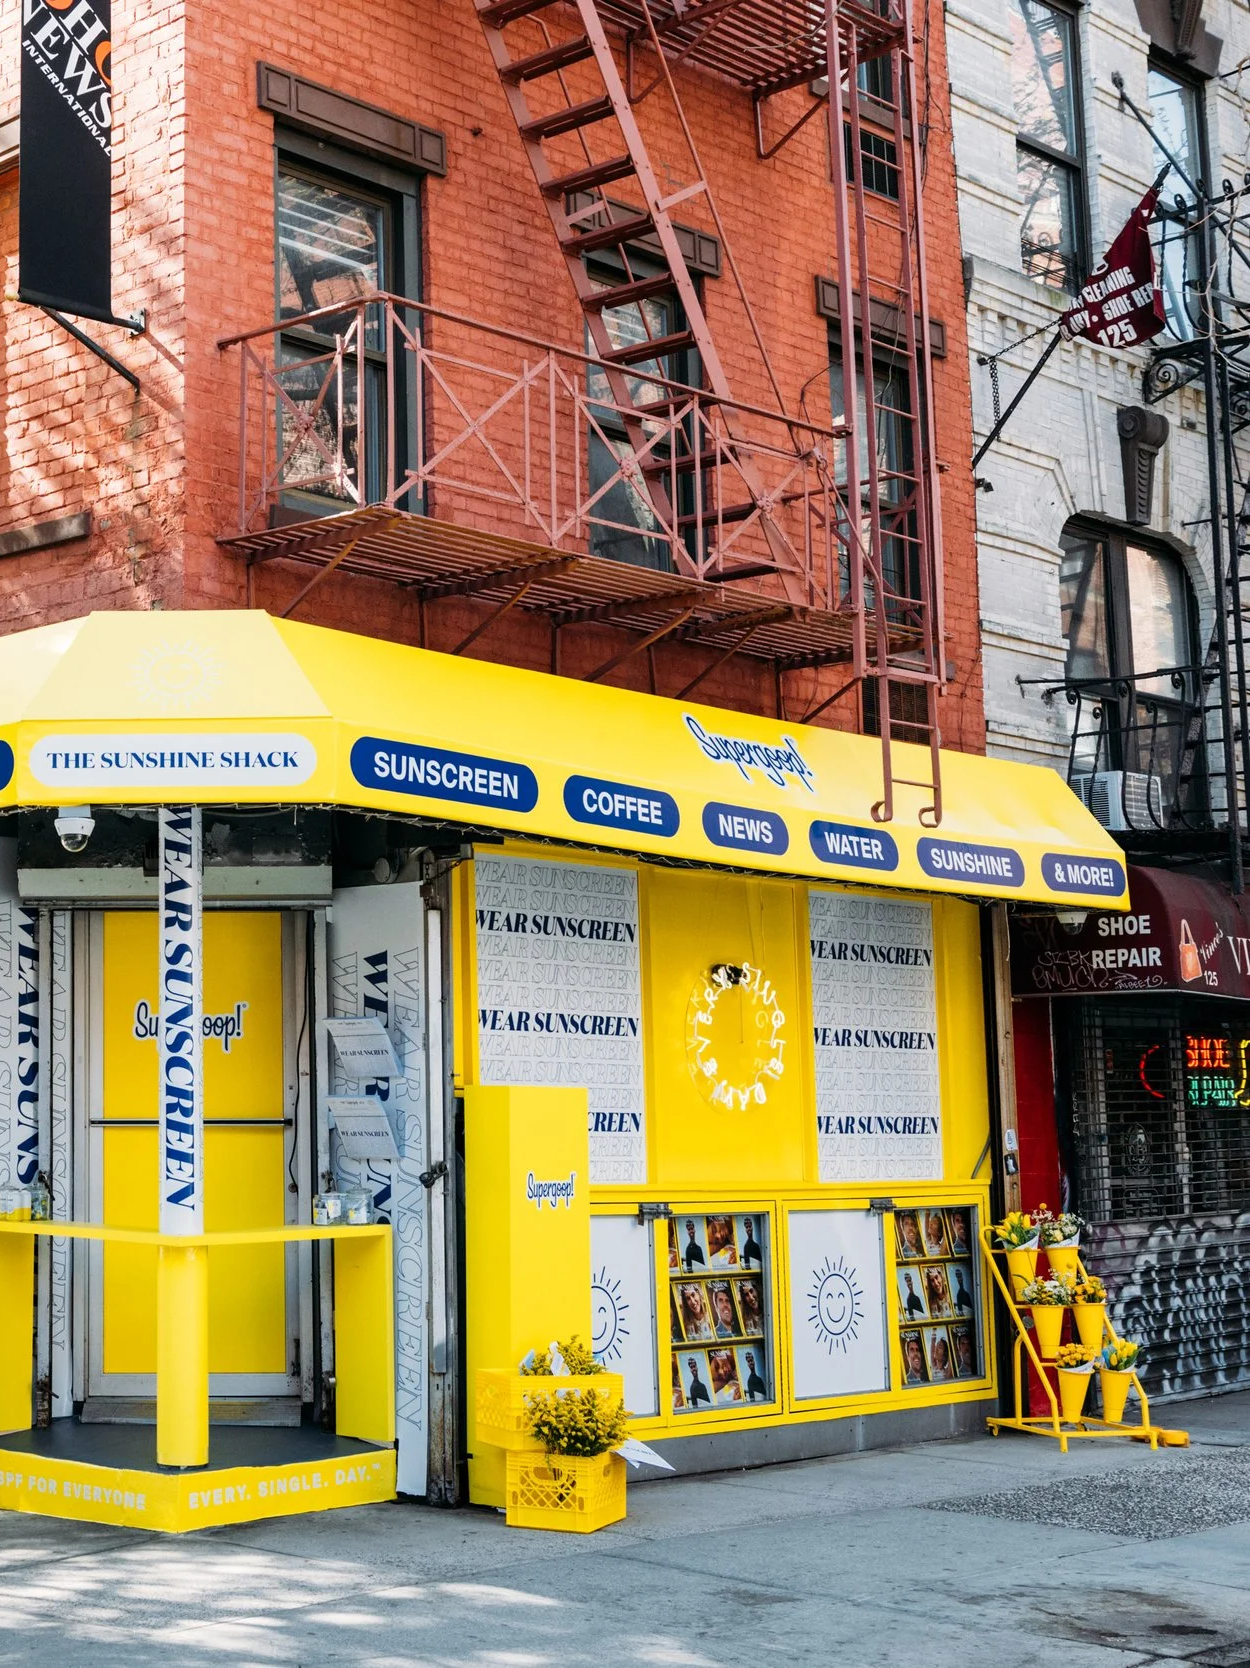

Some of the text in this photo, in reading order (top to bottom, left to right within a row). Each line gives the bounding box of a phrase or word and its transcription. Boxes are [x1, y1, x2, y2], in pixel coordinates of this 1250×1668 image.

[22, 39, 112, 157] INTERNATIONAL
[1082, 266, 1136, 303] CLEANING
[1102, 294, 1135, 321] SHOE
[1097, 319, 1138, 348] 125
[47, 750, 299, 769] THE SUNSHINE SHACK
[684, 714, 814, 792] Supergoop!
[373, 750, 519, 801] SUNSCREEN
[582, 788, 663, 825] COFFEE
[718, 813, 774, 844] NEWS
[824, 831, 885, 861] WATER
[930, 847, 1013, 878] SUNSHINE
[1054, 862, 1115, 889] & MORE!
[529, 866, 636, 896] SUNSCREEN
[530, 891, 636, 920] SUNSCREEN
[476, 910, 636, 943] WEAR SUNSCREEN
[1098, 914, 1151, 936] SHOE
[532, 939, 637, 966] SUNSCREEN
[851, 943, 932, 966] SUNSCREEN
[1091, 947, 1163, 969] REPAIR
[532, 963, 638, 990] SUNSCREEN
[1204, 970, 1219, 986] 125
[533, 988, 638, 1013] SUNSCREEN
[135, 1001, 242, 1051] Suoop!
[478, 1010, 639, 1037] WEAR SUNSCREEN
[534, 1036, 639, 1061] SUNSCREEN
[854, 1028, 936, 1050] SUNSCREEN
[164, 940, 196, 1211] SUNSCREEN
[535, 1061, 640, 1084] SUNSCREEN
[588, 1112, 642, 1132] CREEN
[858, 1116, 939, 1134] SUNSCREEN
[393, 946, 423, 1431] WEAR SUNSCREEN
[527, 1172, 574, 1208] Supergoop!
[28, 1475, 58, 1495] FOR
[63, 1481, 147, 1511] EVERYONE
[189, 1485, 251, 1510] EVERY.
[258, 1471, 328, 1498] SINGLE.
